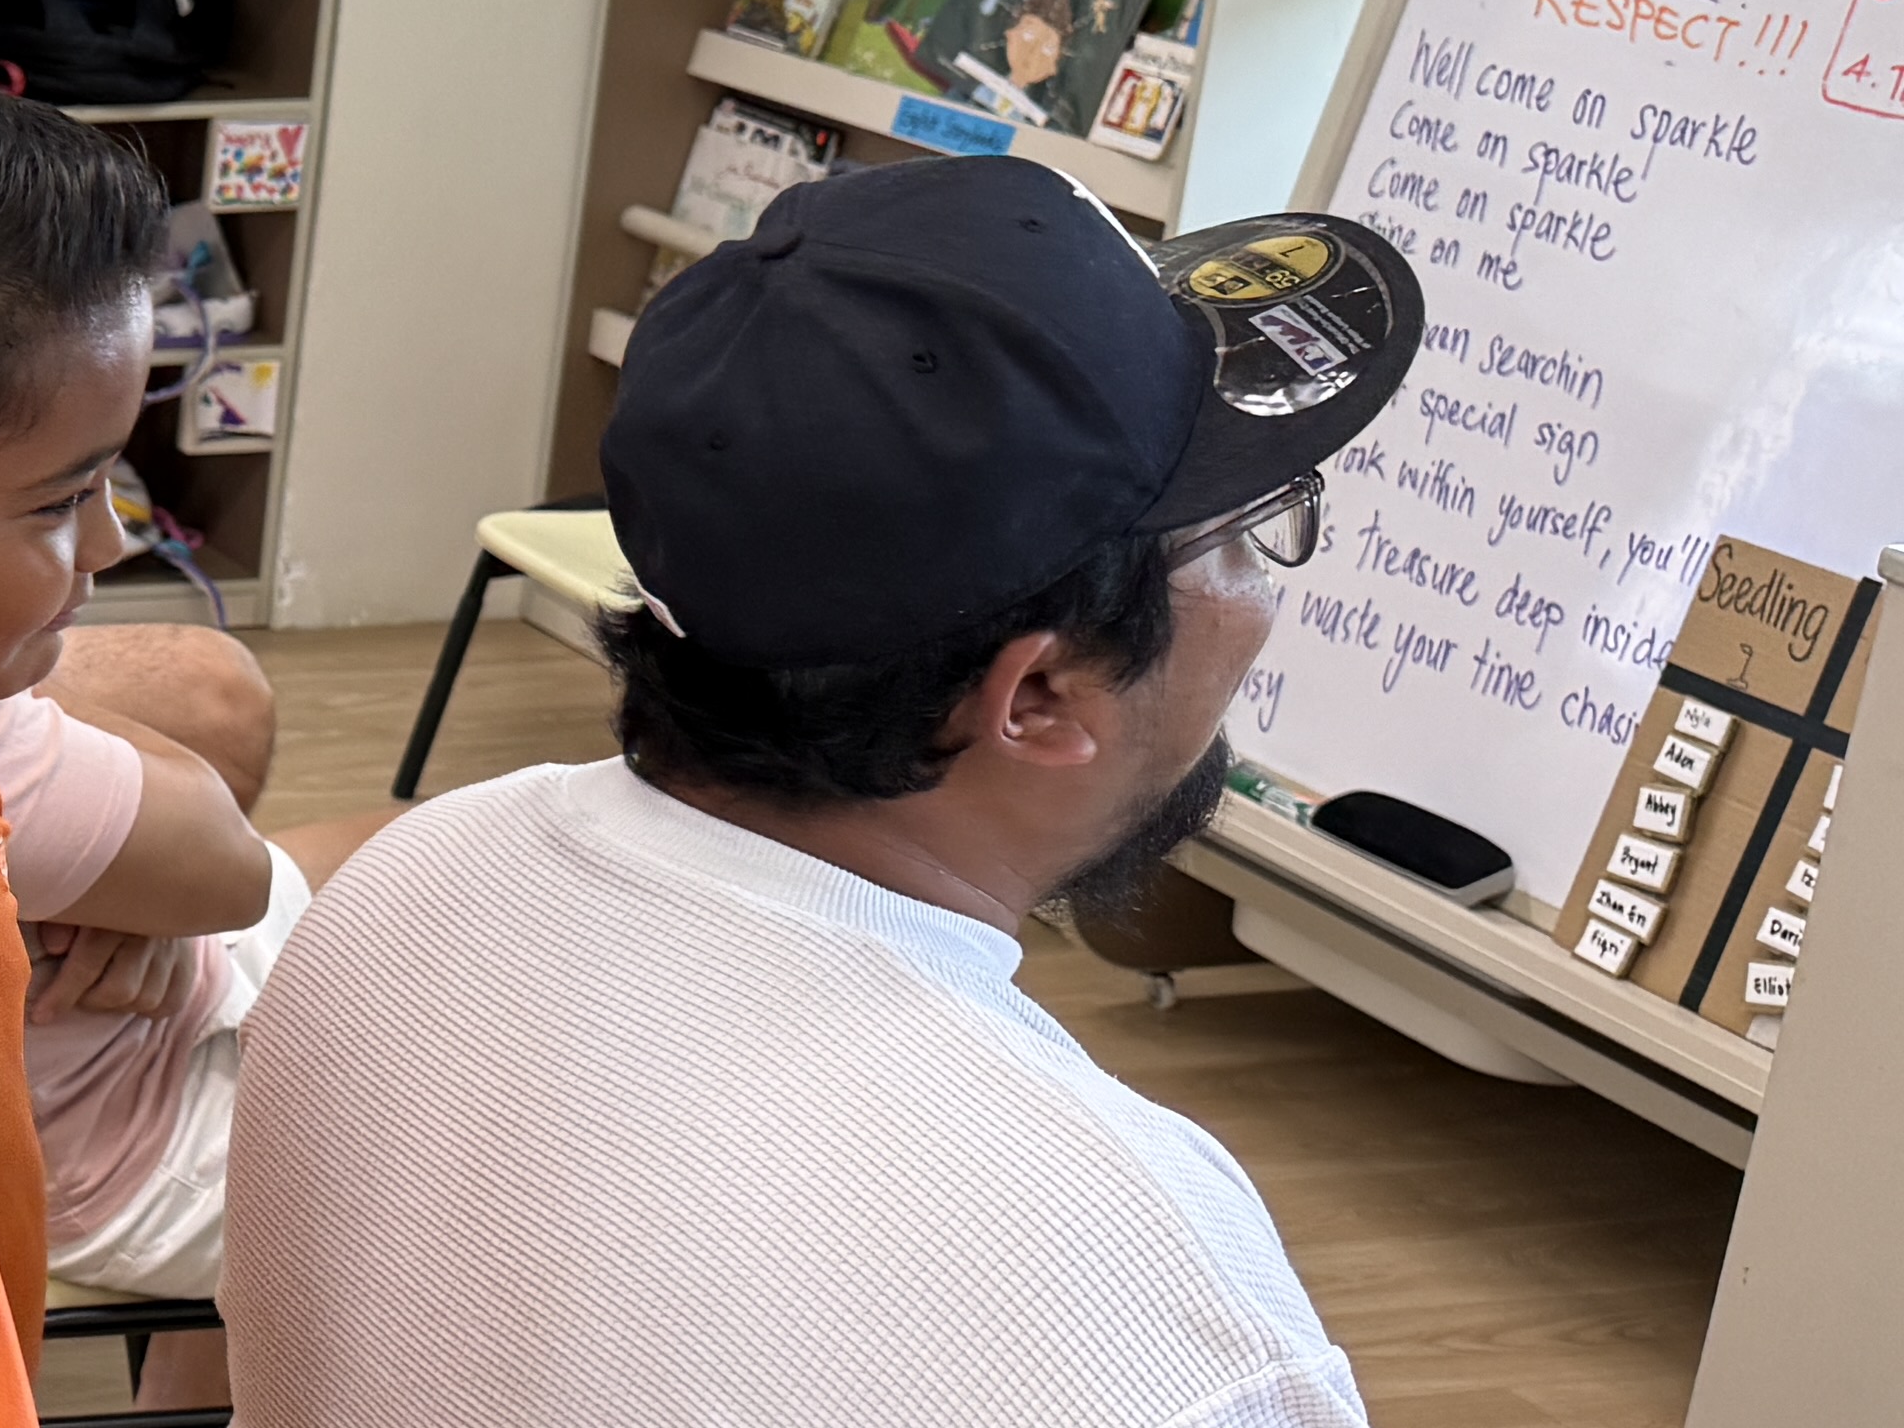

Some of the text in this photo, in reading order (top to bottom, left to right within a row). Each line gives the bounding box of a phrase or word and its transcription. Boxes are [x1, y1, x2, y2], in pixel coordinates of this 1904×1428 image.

[1390, 100, 1638, 205] Come on sparkle
[1409, 29, 1760, 181] Well come on sparkle
[1367, 157, 1617, 262] Come on sparkle
[1429, 236, 1461, 268] on
[1477, 248, 1524, 291] me
[1423, 322, 1472, 363] een
[1478, 333, 1605, 409] searchin
[1420, 388, 1518, 446] special
[1533, 421, 1600, 485] sign
[1397, 459, 1477, 517] within
[1487, 493, 1614, 570] yourself,
[1616, 531, 1711, 587] you'll
[1356, 510, 1479, 607] treasure
[1495, 573, 1565, 654] deep
[1697, 542, 1830, 663] Seedling
[1299, 590, 1639, 746] waste your time chasi
[1644, 794, 1678, 827] Abbey
[1769, 918, 1804, 947] Dari
